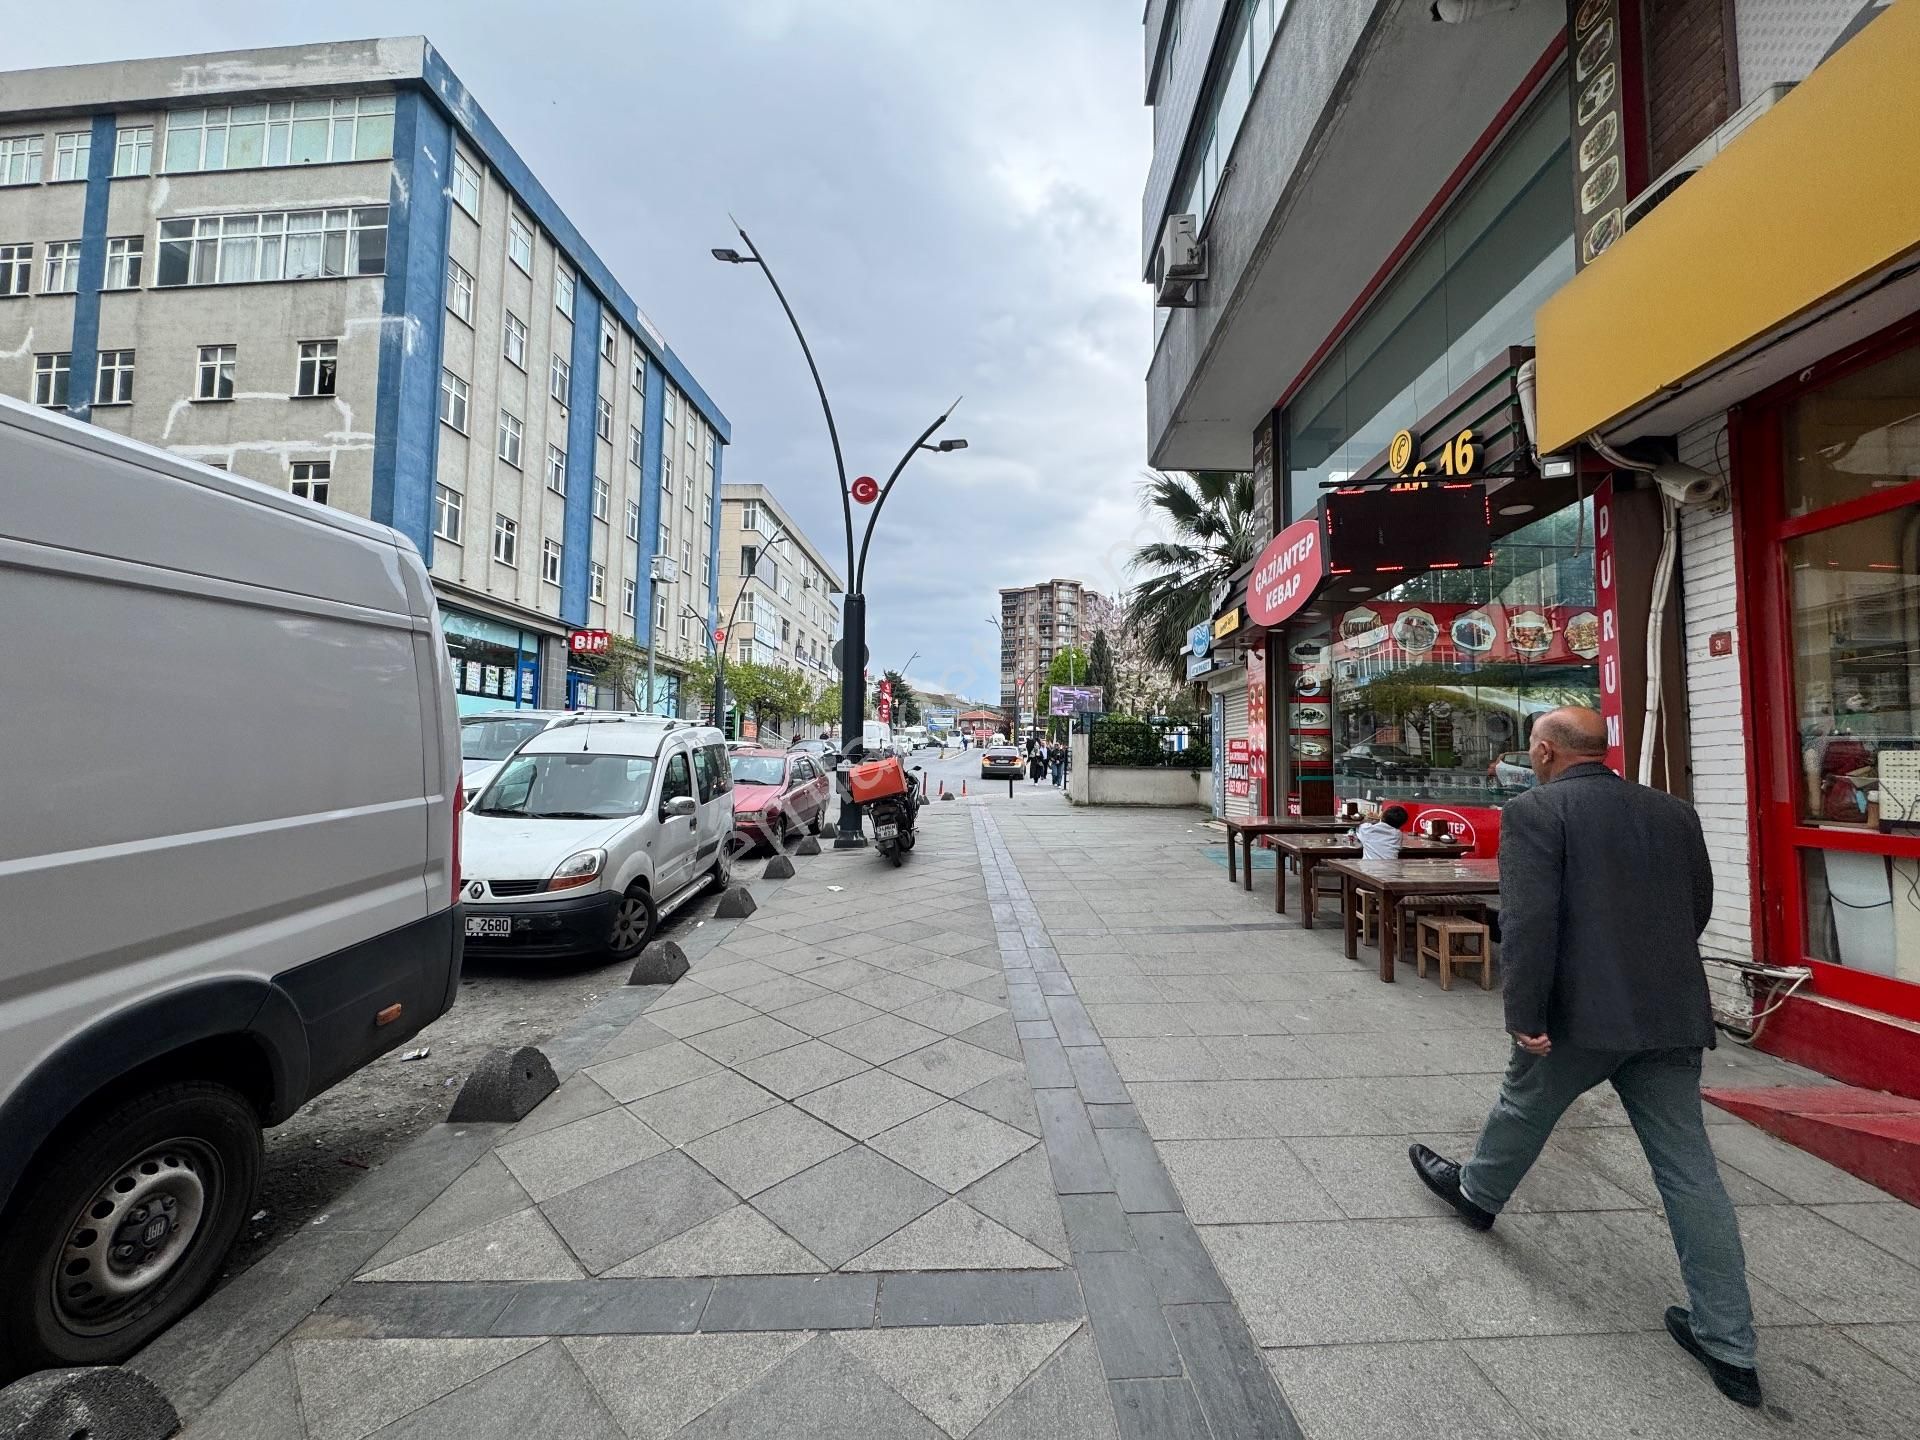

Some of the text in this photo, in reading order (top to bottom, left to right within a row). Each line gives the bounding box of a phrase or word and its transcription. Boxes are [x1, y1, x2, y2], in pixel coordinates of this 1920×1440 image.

[1265, 573, 1301, 613] KEBAP
[1600, 505, 1620, 747] DÜRÜM
[480, 918, 509, 932] 2680
